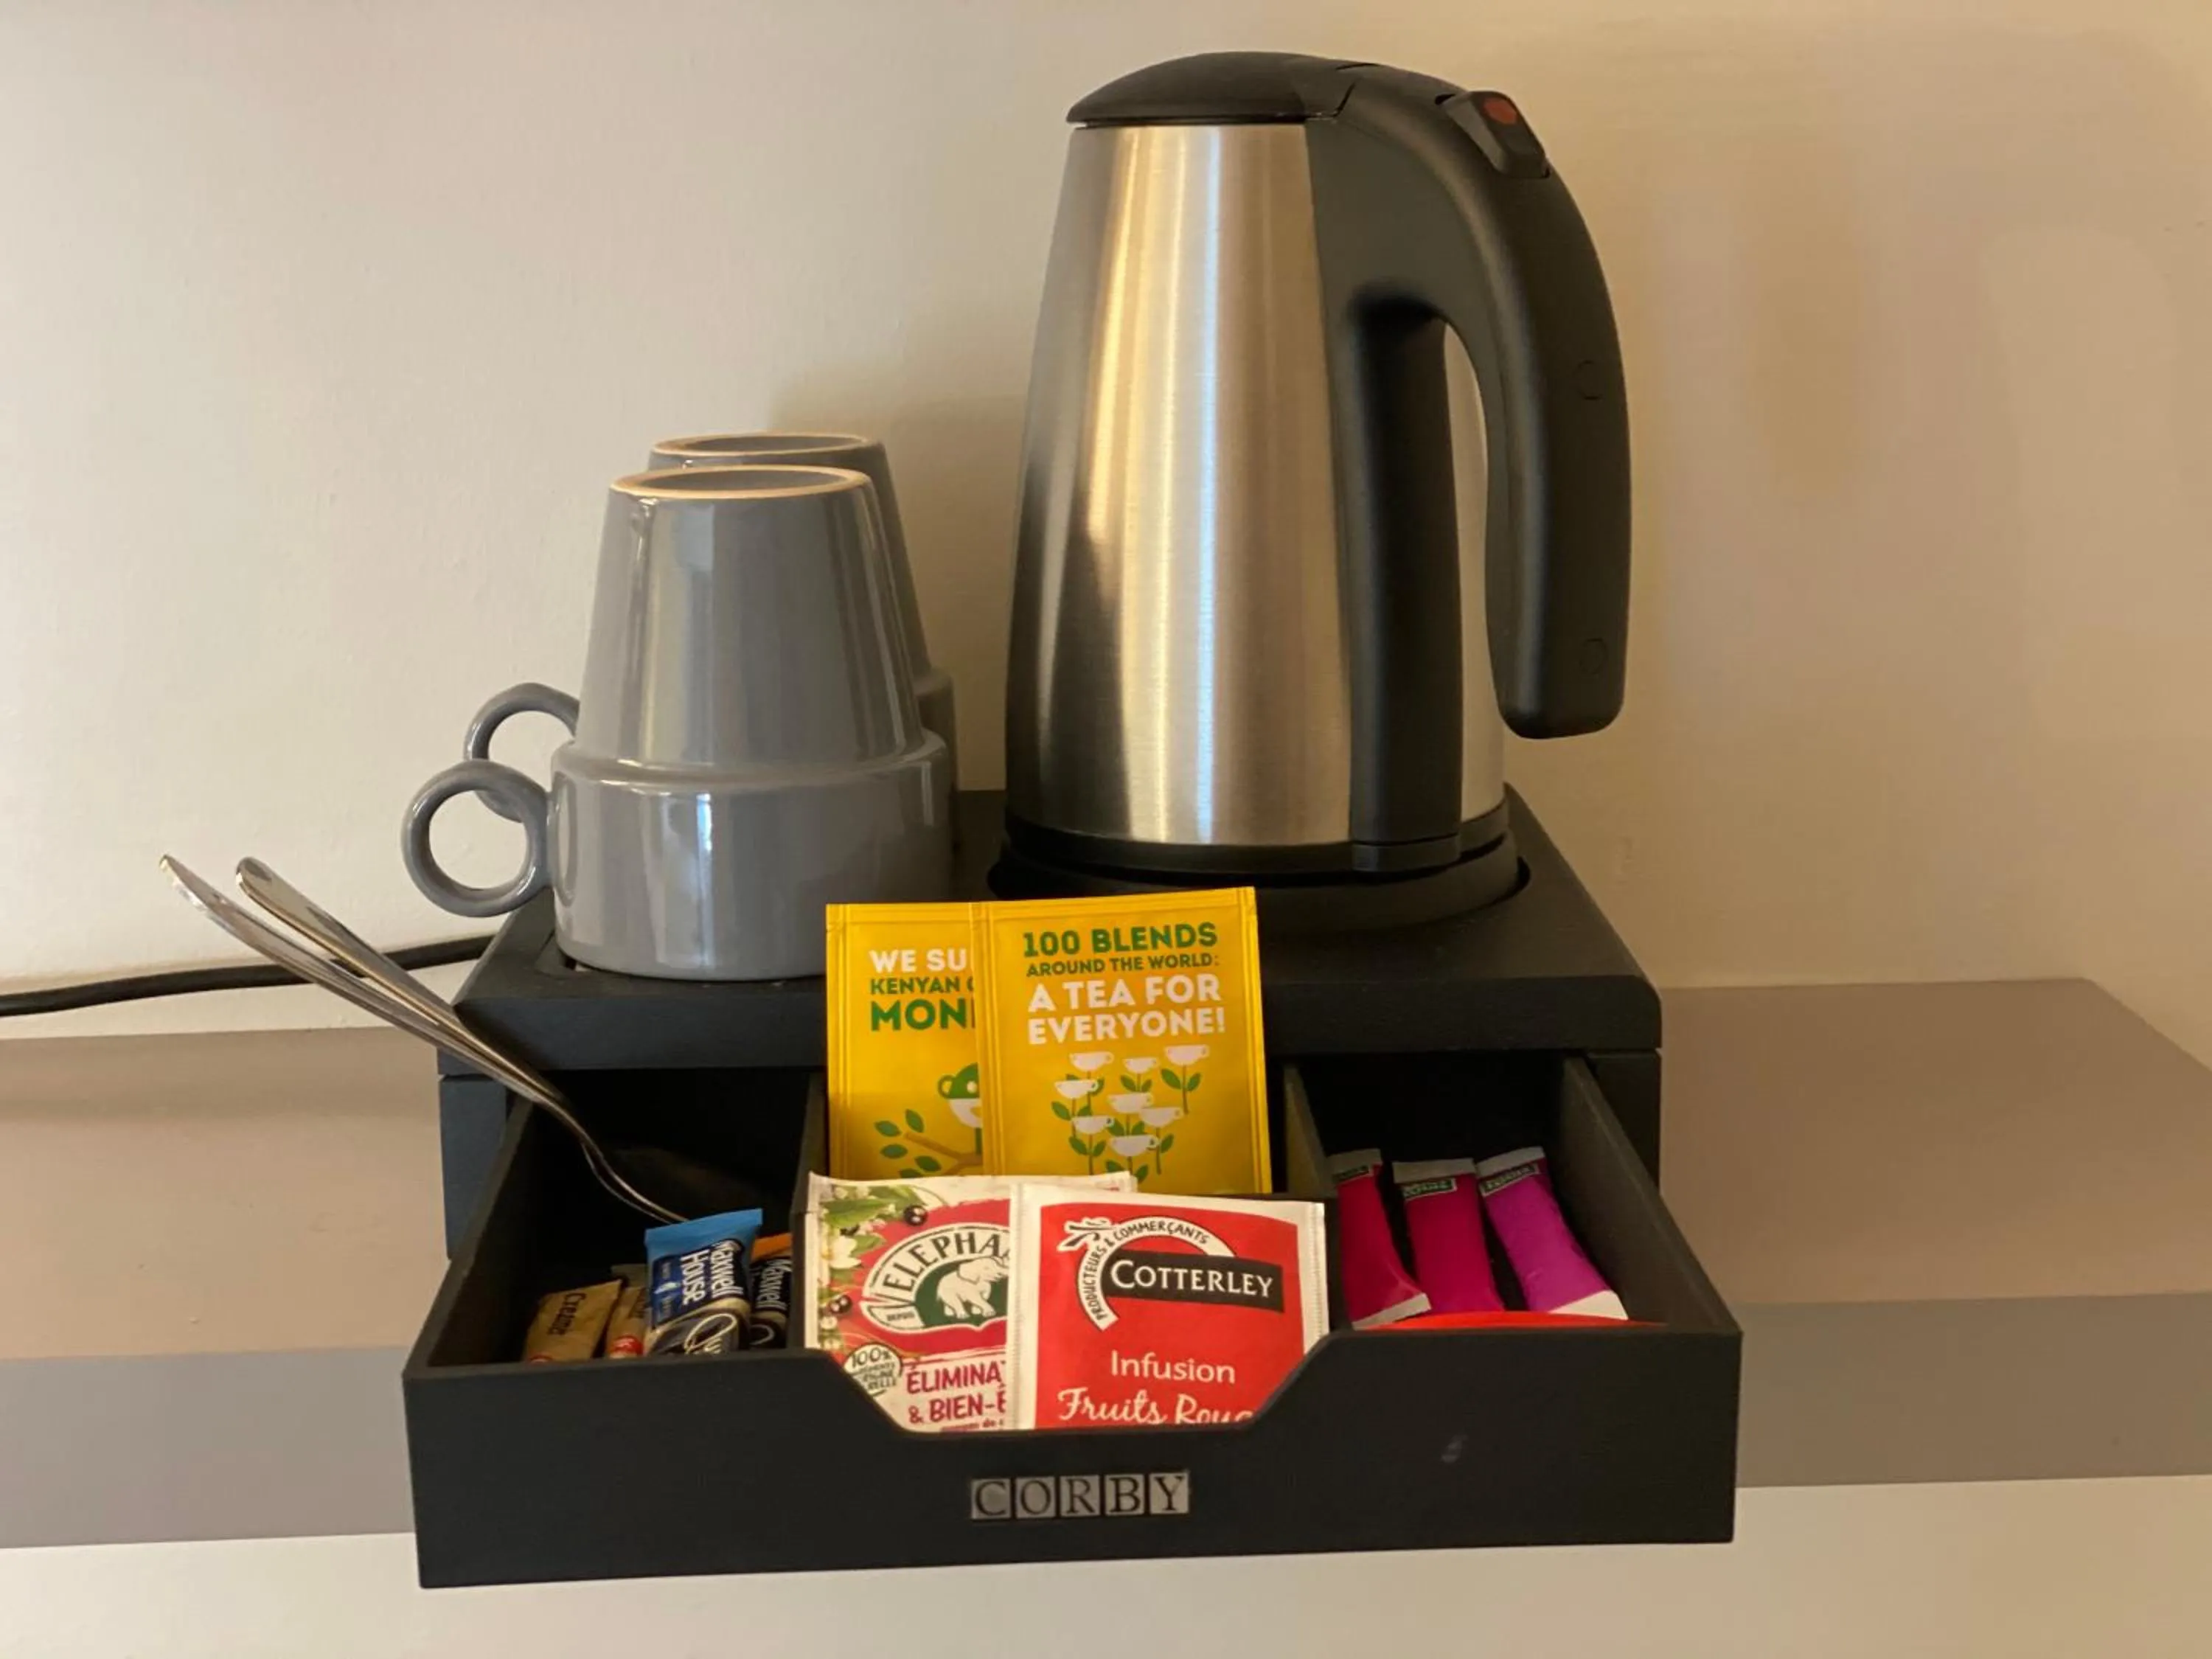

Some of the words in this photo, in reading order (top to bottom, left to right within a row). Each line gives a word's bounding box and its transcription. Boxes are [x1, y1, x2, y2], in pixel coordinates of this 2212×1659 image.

[1023, 930, 1081, 958] 100
[1091, 922, 1218, 953] BLENDS
[869, 949, 917, 973] WE
[1026, 959, 1105, 978] AROUND
[1109, 956, 1144, 972] THE
[1147, 952, 1220, 970] WORLD:
[870, 975, 961, 995] KENYAN
[1028, 982, 1057, 1013] A
[1062, 978, 1136, 1010] TEA
[1145, 973, 1222, 1006] FOR
[871, 997, 975, 1032] MON
[1028, 1006, 1225, 1046] EVERYONE!
[680, 1248, 711, 1306] House
[883, 1231, 1010, 1293] ELEPHA
[1082, 1245, 1108, 1321] PRODUCTEURS
[1113, 1220, 1210, 1245] COMMERÇANTS
[906, 1359, 1006, 1394] ÉLIMINA
[1110, 1349, 1236, 1385] Infusion
[908, 1405, 924, 1424] &
[1057, 1387, 1168, 1425] Fruits
[974, 1475, 1184, 1517] CORBY
